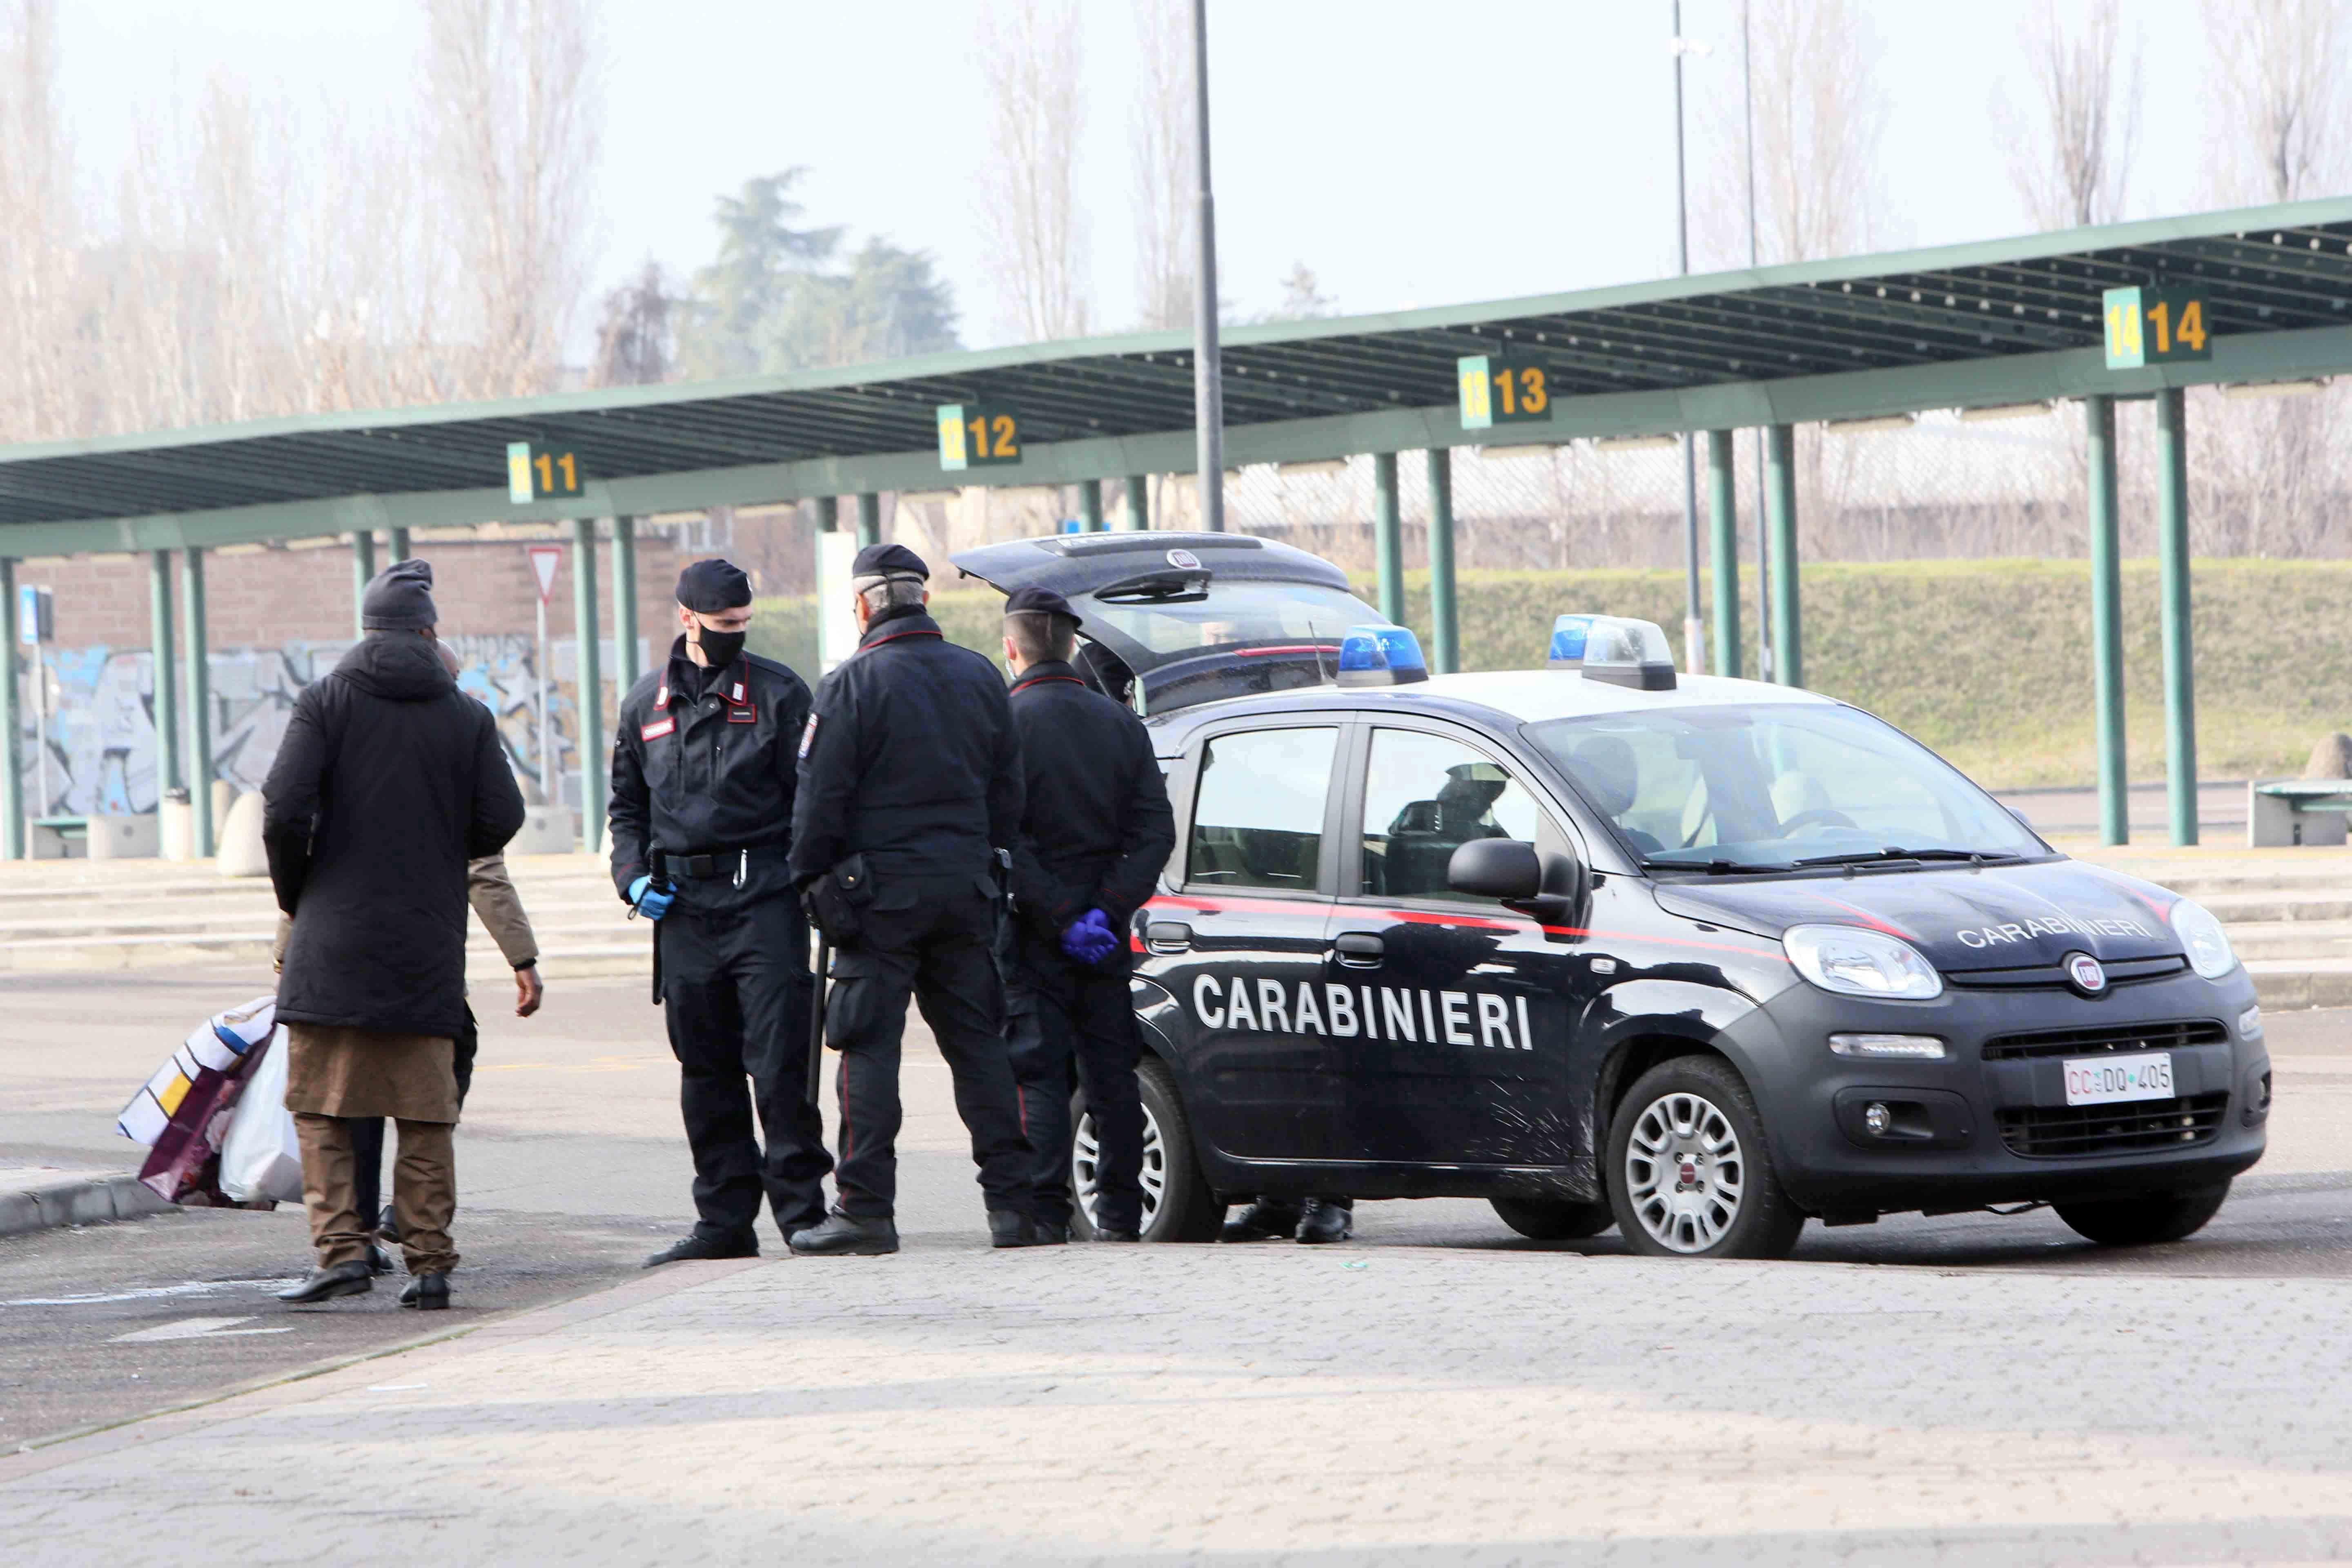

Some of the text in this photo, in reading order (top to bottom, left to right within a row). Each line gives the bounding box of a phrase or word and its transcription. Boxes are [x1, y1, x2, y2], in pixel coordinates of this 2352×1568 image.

[2147, 301, 2207, 352] 14
[1493, 367, 1547, 414] 13
[968, 415, 1018, 457] 12
[533, 452, 577, 492] 11
[1956, 917, 2153, 948] CARABINIERI
[1192, 974, 1533, 1050] CARABINIERI
[2069, 1068, 2091, 1095] CC
[2138, 1063, 2170, 1089] 405
